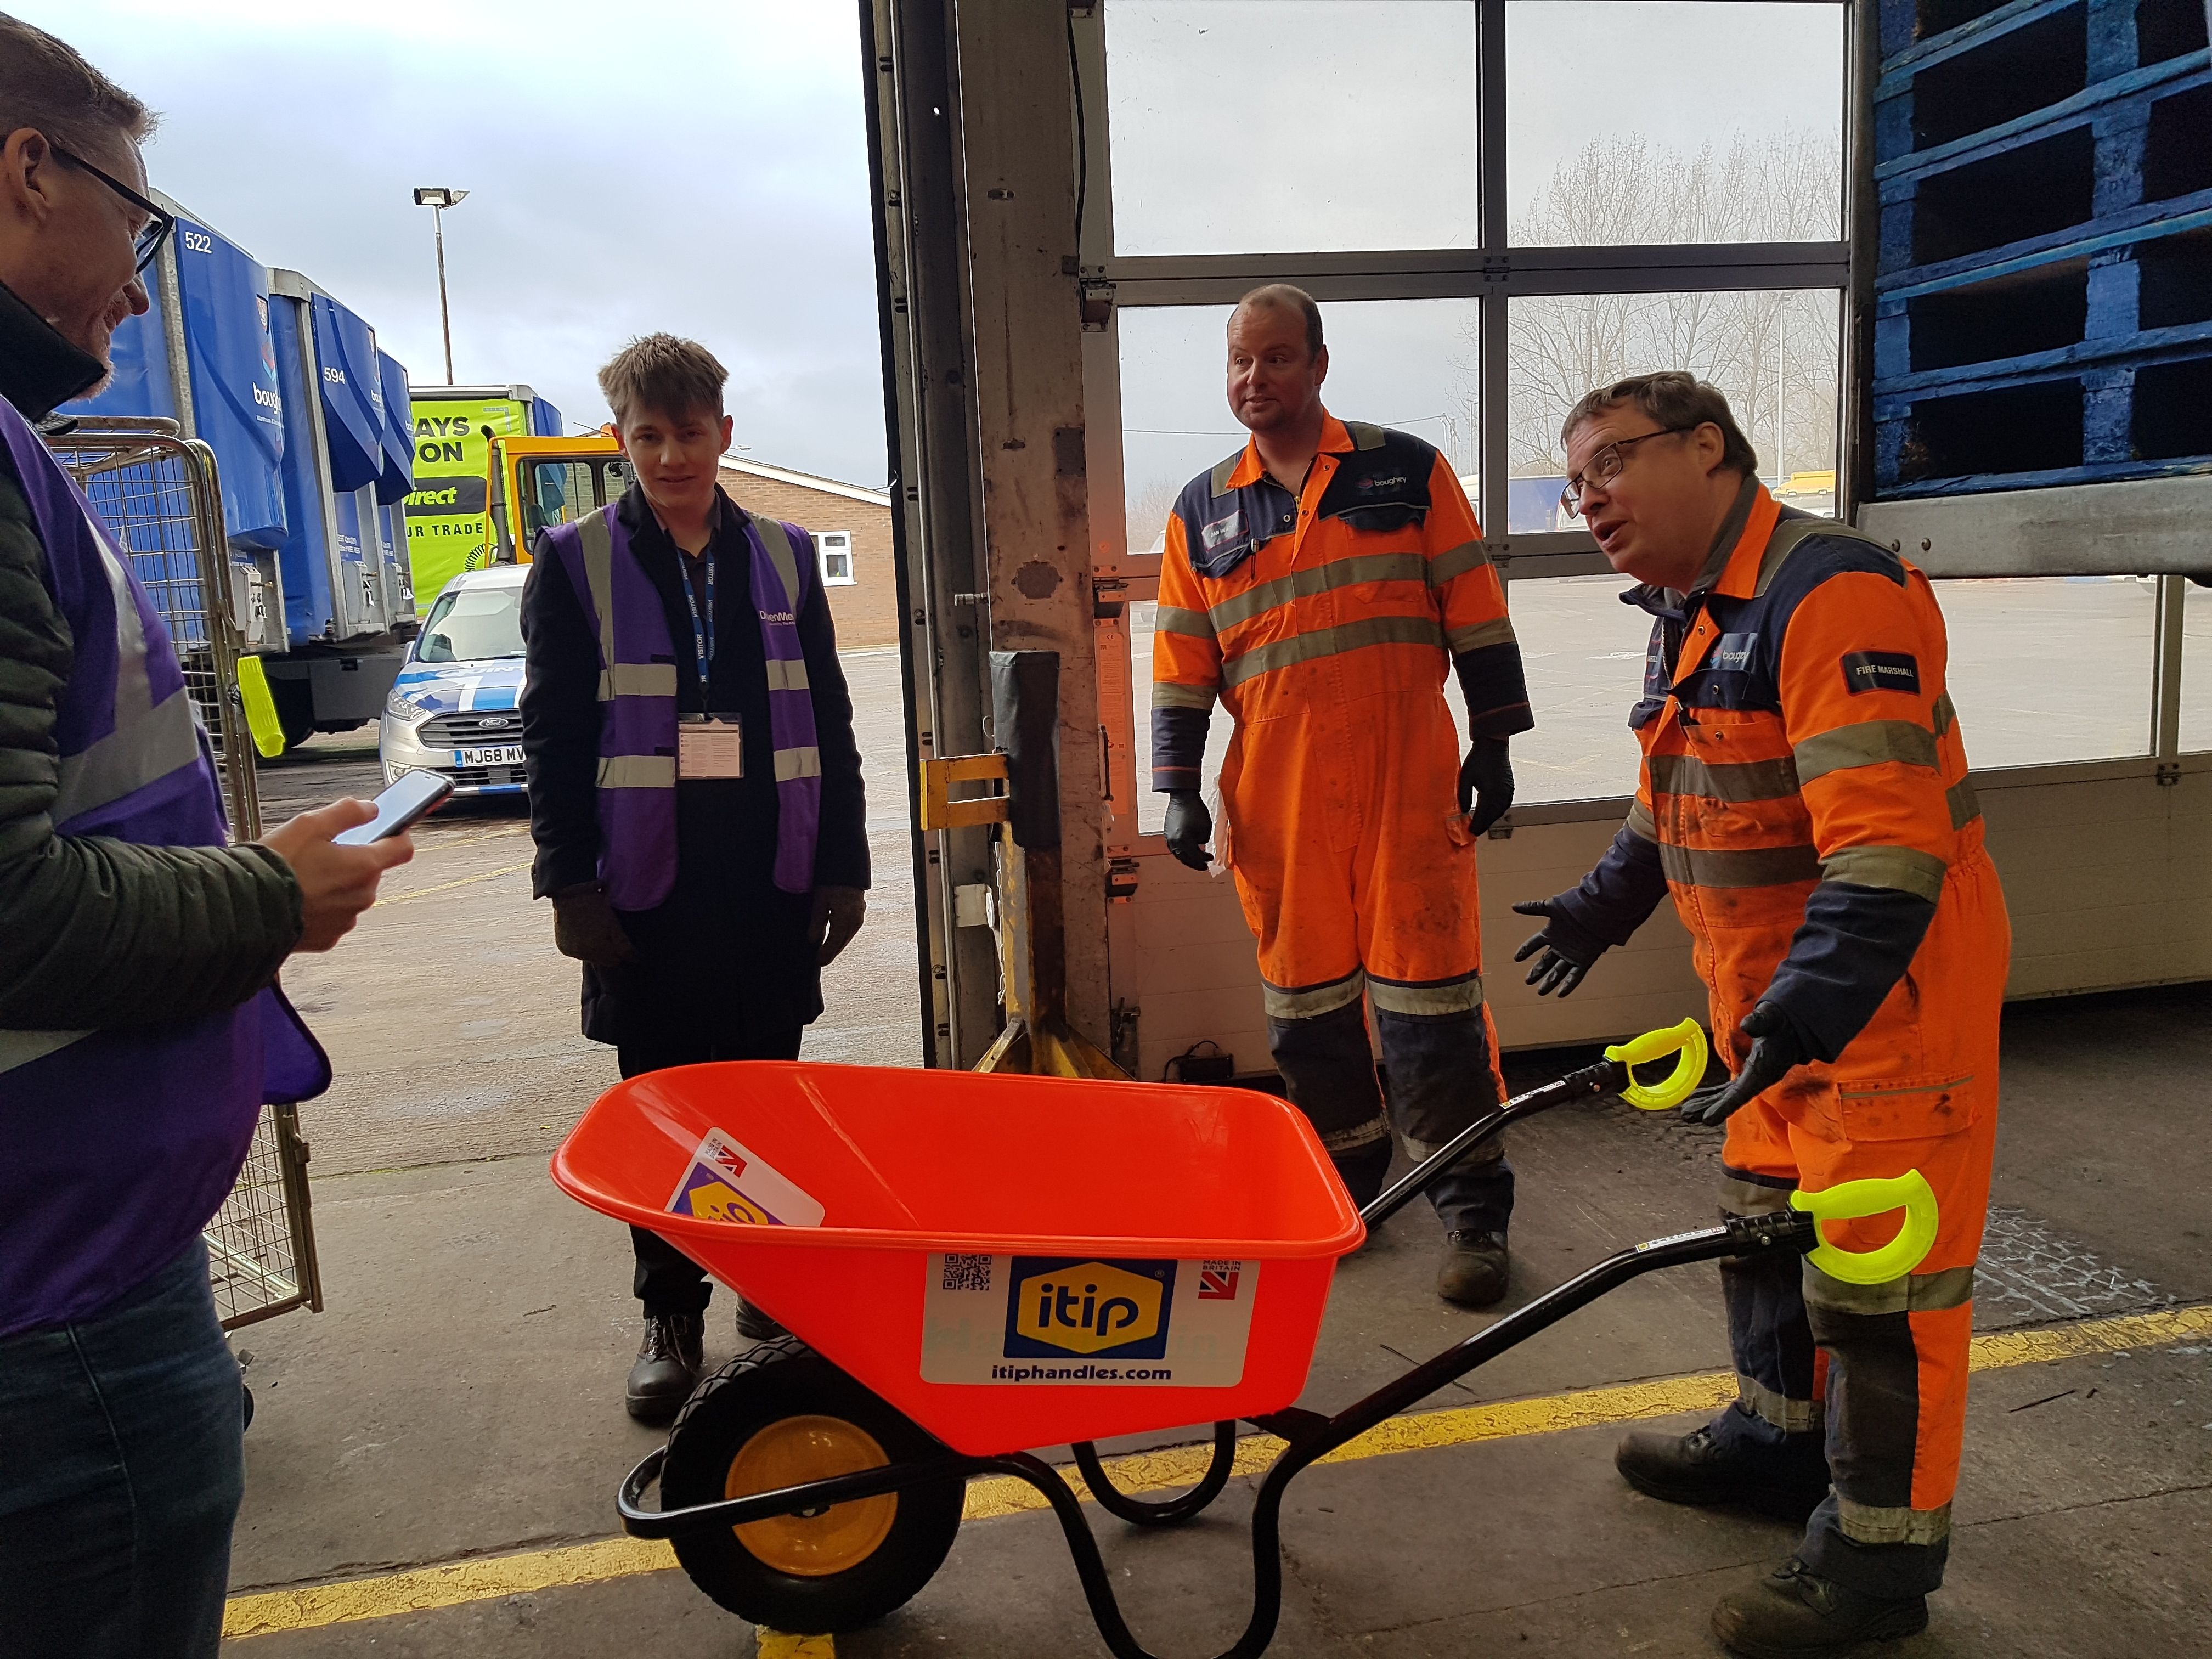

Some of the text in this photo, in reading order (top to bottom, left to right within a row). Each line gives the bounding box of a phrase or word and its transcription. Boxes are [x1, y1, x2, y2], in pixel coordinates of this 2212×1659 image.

[185, 232, 212, 253] 522
[324, 367, 345, 384] 594
[413, 416, 470, 437] AYS
[419, 442, 463, 462] ON
[1374, 476, 1407, 486] boughey
[432, 523, 483, 536] TRADE
[688, 594, 698, 618] VISITOR
[696, 634, 704, 659] VISITOR
[1856, 665, 1914, 678] FIRE MARSHALL
[464, 748, 524, 764] MJ68 MV
[1038, 1282, 1139, 1337] itip
[991, 1365, 1172, 1382] itiphandles.com
